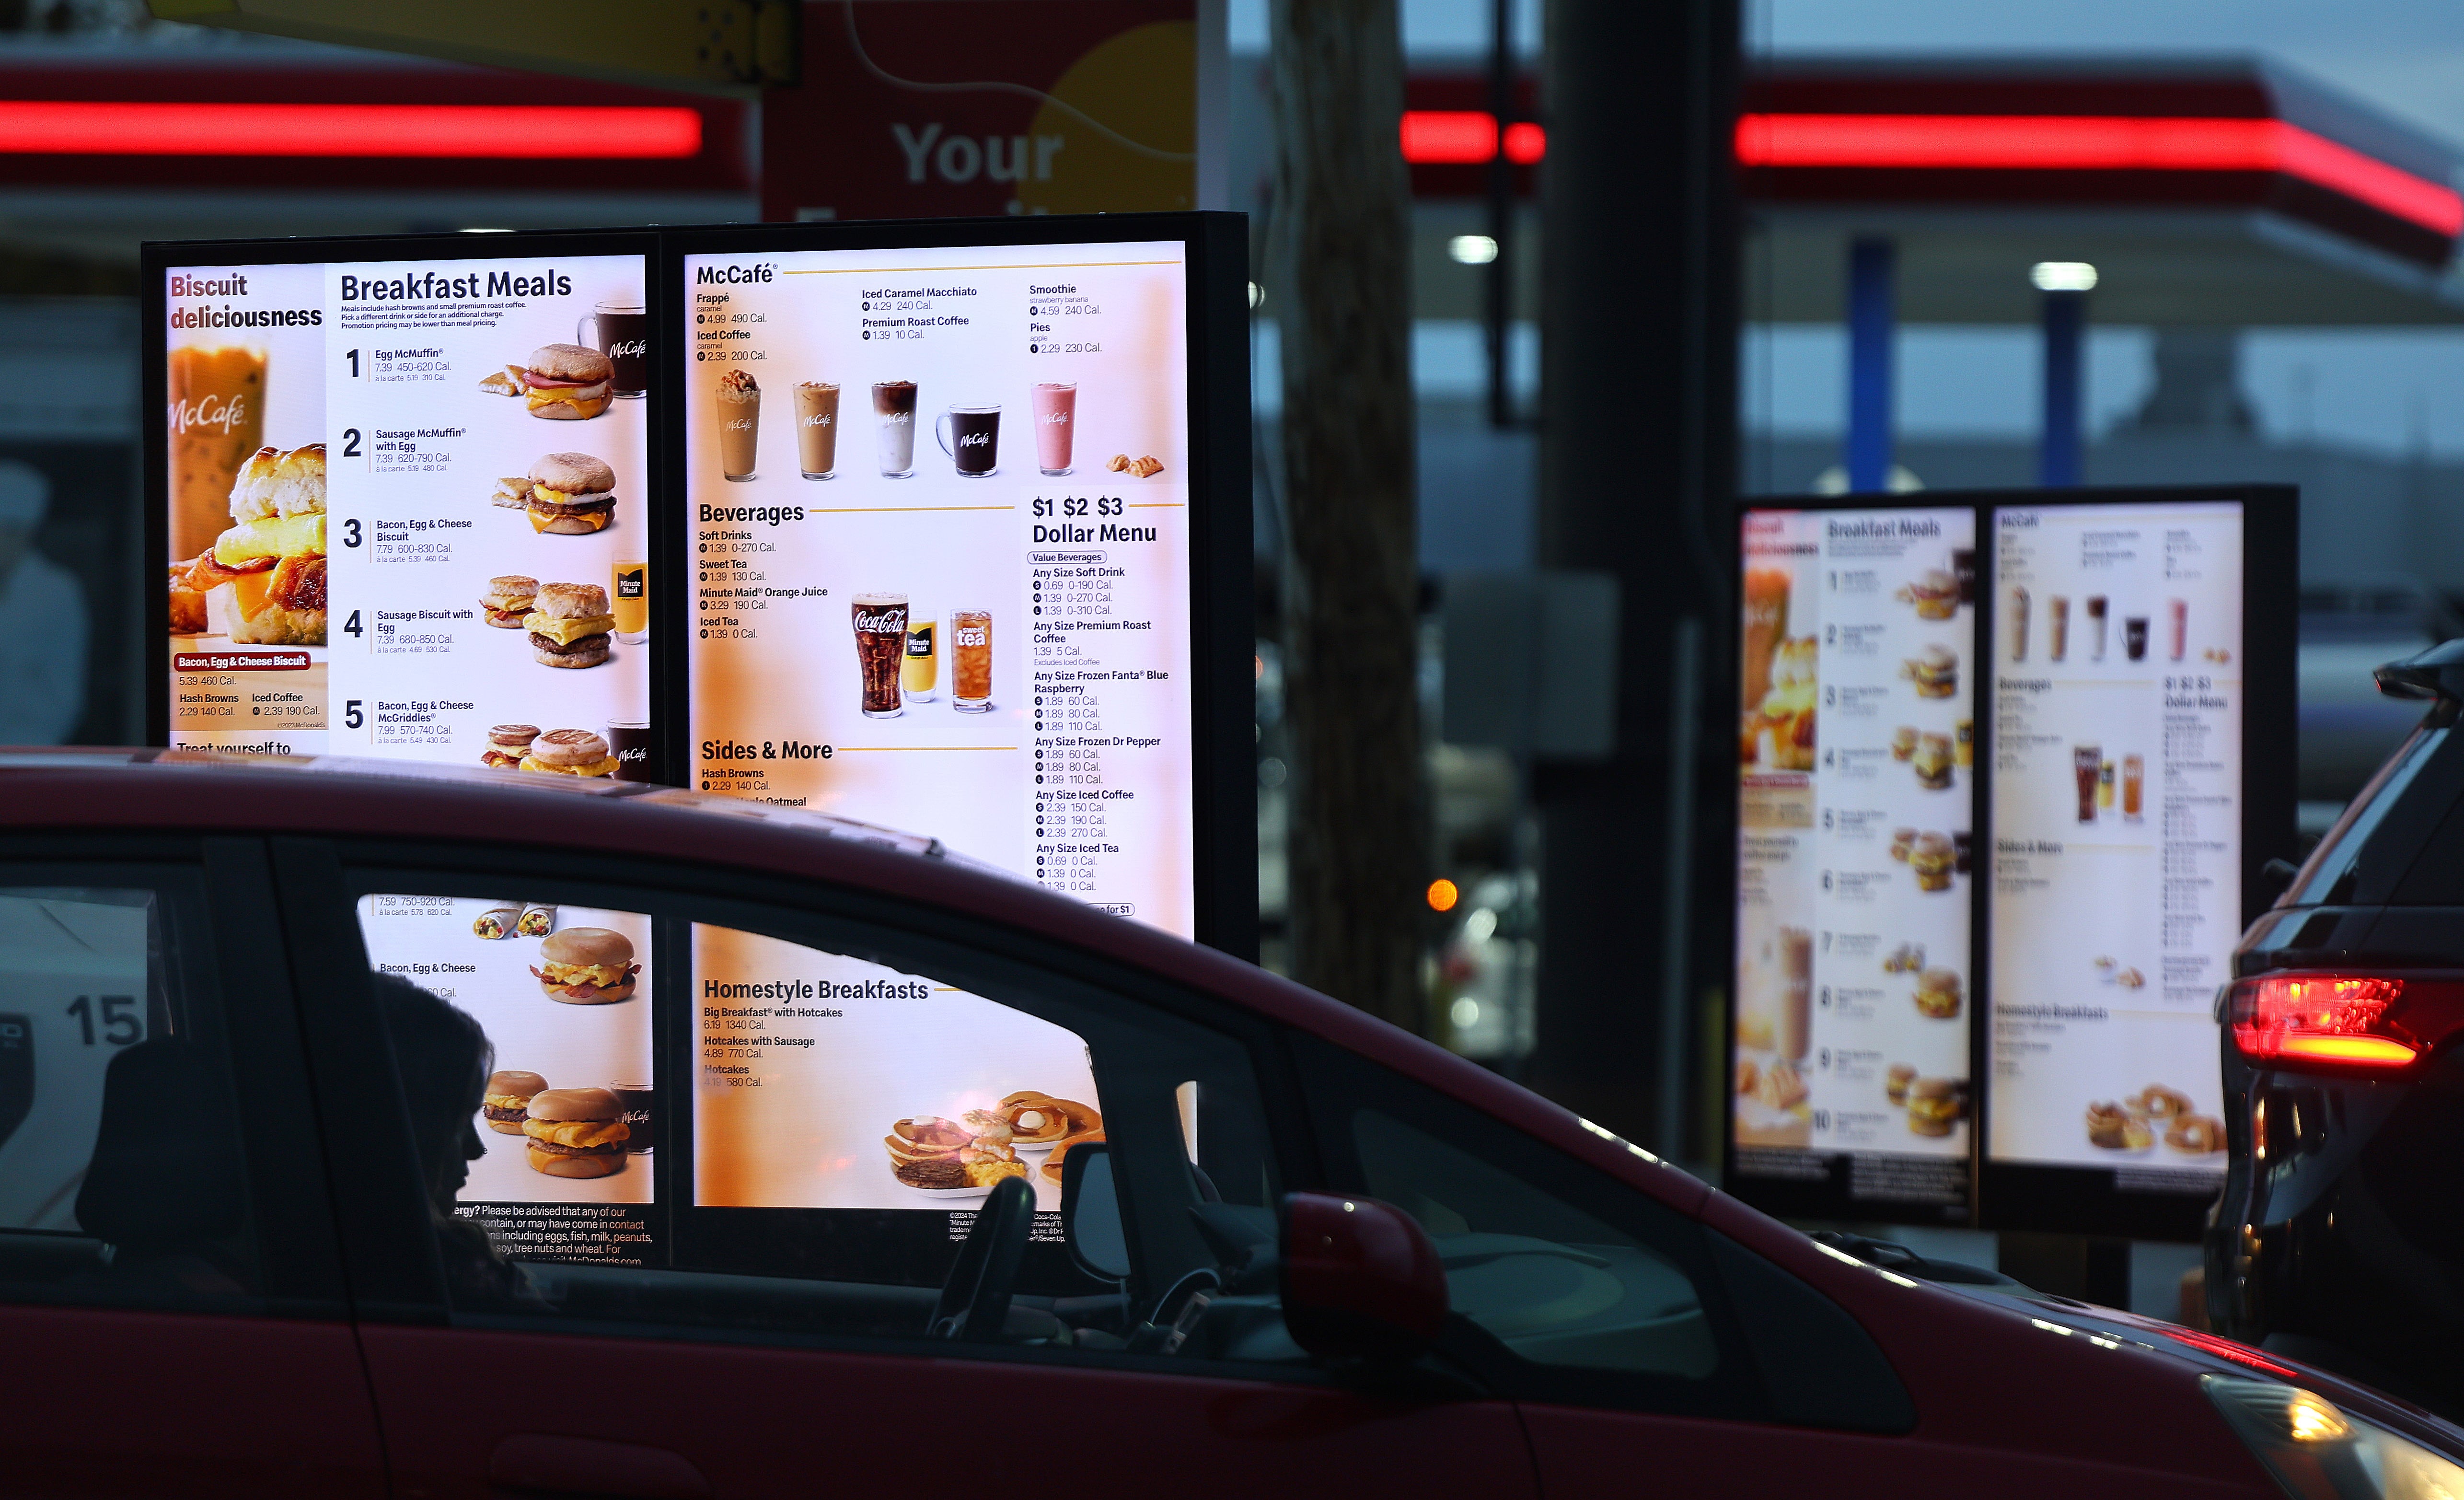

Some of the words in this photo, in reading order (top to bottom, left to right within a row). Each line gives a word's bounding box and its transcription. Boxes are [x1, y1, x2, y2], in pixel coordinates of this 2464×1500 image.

[891, 122, 1065, 183] Your
[172, 272, 248, 297] Biscuit
[342, 272, 480, 301] Breakfast
[487, 269, 571, 297] Meals
[1030, 284, 1076, 294] Smoothie
[697, 292, 730, 305] Frappé
[863, 289, 882, 298] Iced
[885, 288, 924, 298] Caramel
[927, 287, 977, 297] Macchiato
[1030, 296, 1064, 304] strawberry
[171, 304, 322, 328] deliciousness
[707, 314, 726, 324] 4.99
[731, 314, 748, 323] 490
[751, 313, 767, 322] Cal.
[863, 317, 905, 327] Premium
[908, 317, 936, 326] Roast
[937, 316, 969, 325] Coffee
[1031, 323, 1050, 332] Pies
[1030, 334, 1048, 343] apple
[376, 350, 392, 360] Egg
[610, 339, 646, 359] McCafé
[347, 349, 359, 377] 1
[375, 363, 392, 372] 7.39
[397, 362, 433, 371] 450-620
[436, 361, 451, 371] Cal.
[804, 413, 831, 427] McCafé
[376, 430, 415, 440] Sausage
[960, 433, 990, 447] McCafé
[344, 428, 361, 457] 2
[376, 441, 396, 450] with
[399, 442, 416, 453] Egg
[1033, 496, 1053, 519] $1
[1064, 496, 1088, 518] $2
[1098, 495, 1123, 518] $3
[700, 504, 804, 526] Beverages
[344, 519, 362, 547] 3
[699, 531, 719, 540] Soft
[721, 530, 752, 540] Drinks
[1034, 523, 1094, 543] Dollar
[1100, 524, 1156, 542] Menu
[709, 543, 727, 552] 1.39
[732, 543, 757, 552] 0-270
[760, 543, 776, 552] Cal.
[700, 560, 729, 569] Sweet
[730, 559, 747, 568] Tea
[1033, 553, 1056, 561] Value
[1058, 553, 1102, 563] Beverages
[1032, 569, 1052, 580] Any
[1054, 568, 1074, 577] Size
[1076, 568, 1096, 576] Soft
[1099, 567, 1125, 576] Drink
[1044, 581, 1063, 590] 0.69
[1069, 581, 1093, 590] 0-190
[1096, 580, 1113, 589] Cal.
[700, 588, 733, 597] Minute
[765, 588, 799, 599] Orange
[802, 586, 828, 596] Juice
[378, 611, 416, 621] Sausage
[419, 609, 451, 619] Biscuit
[453, 609, 473, 618] with
[344, 610, 363, 638] 4
[377, 624, 395, 634] Egg
[957, 630, 985, 646] tea
[179, 657, 209, 668] Bacon,
[211, 657, 228, 668] Egg
[229, 657, 237, 666] &
[238, 656, 272, 666] Cheese
[273, 655, 306, 665] Biscuit
[180, 694, 203, 703] Hash
[205, 694, 239, 702] Browns
[252, 693, 271, 702] Iced
[273, 693, 303, 702] Coffee
[346, 700, 363, 729] 5
[1035, 737, 1054, 748] Any
[1056, 736, 1076, 746] Size
[1078, 737, 1111, 746] Frozen
[1113, 737, 1124, 745] Dr
[1127, 737, 1161, 748] Pepper
[276, 743, 292, 756] to
[702, 739, 757, 760] Sides
[762, 741, 776, 759] &
[782, 741, 833, 759] More
[766, 797, 806, 806] Oatmeal
[379, 897, 396, 907] 7.59
[401, 897, 437, 906] 750-920
[439, 897, 455, 906] Cal.
[705, 979, 813, 1005] Homestyle
[819, 979, 929, 1000] Breakfasts
[67, 994, 143, 1046] 15
[704, 1035, 750, 1046] Hotcakes
[751, 1036, 772, 1045] with
[774, 1036, 815, 1048] Sausage
[482, 1205, 511, 1215] Please
[513, 1206, 524, 1215] be
[525, 1205, 561, 1216] advised
[562, 1206, 580, 1216] that
[582, 1209, 598, 1219] any
[600, 1207, 609, 1216] of
[502, 1230, 544, 1242] including
[545, 1232, 569, 1242] eggs,
[571, 1231, 589, 1242] fish,
[591, 1231, 612, 1243] milk,
[614, 1233, 653, 1244] peanuts,
